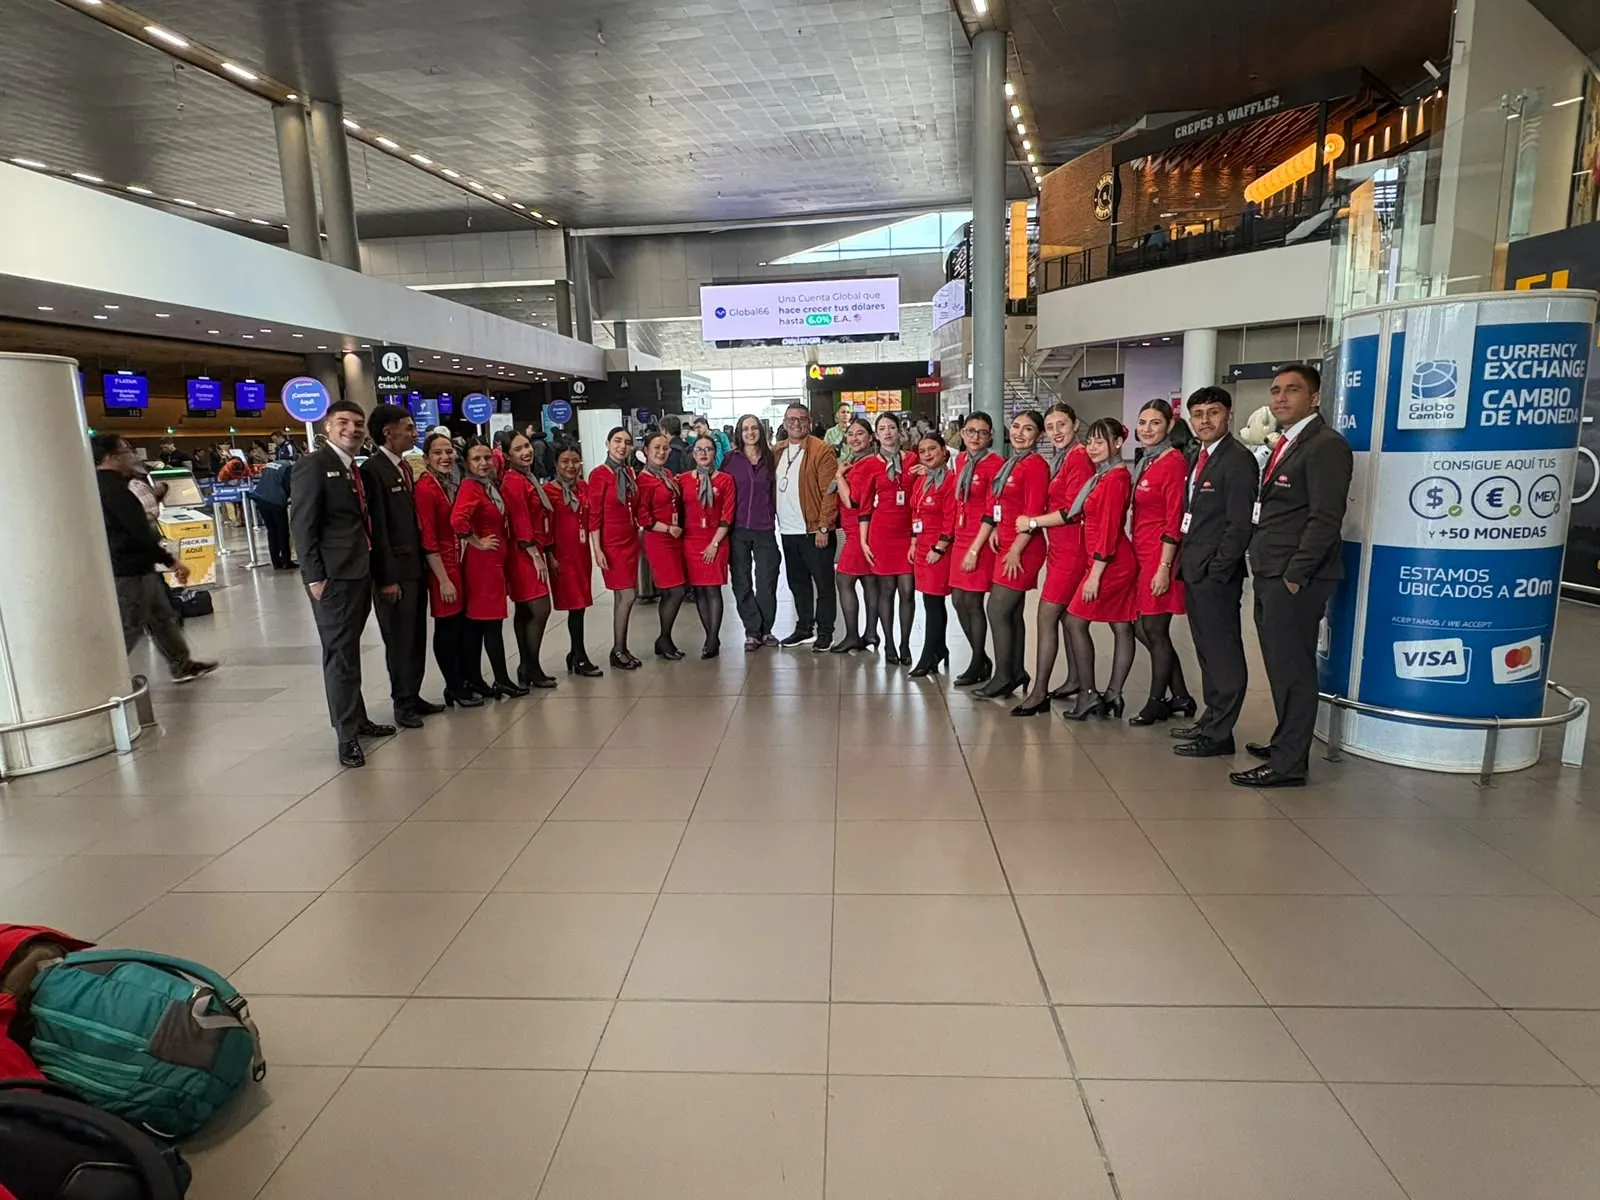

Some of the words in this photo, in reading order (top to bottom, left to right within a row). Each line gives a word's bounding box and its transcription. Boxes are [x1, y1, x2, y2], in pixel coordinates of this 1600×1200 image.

[1175, 116, 1214, 139] CREPES
[1216, 113, 1225, 125] &
[1227, 95, 1280, 121] WAFFLES
[778, 295, 796, 304] Una
[800, 294, 831, 303] Cuenta
[832, 292, 861, 301] Global
[863, 292, 880, 301] que
[729, 308, 769, 317] Global66
[778, 306, 800, 314] hace
[803, 305, 832, 313] crecer
[834, 304, 849, 312] tus
[851, 302, 885, 311] dólares
[779, 316, 804, 325] hasta
[808, 316, 830, 324] 6.0%
[833, 315, 852, 323] E.A.
[1486, 343, 1578, 360] CURRENCY
[1483, 360, 1586, 380] EXCHANGE
[1482, 387, 1571, 409] CAMBIO
[1409, 403, 1455, 412] Globo
[1409, 411, 1454, 420] Cambio
[1480, 410, 1512, 426] DE
[1516, 407, 1579, 425] MONEDA
[1433, 460, 1502, 471] CONSIGUE
[1505, 457, 1535, 471] AQUÍ
[1538, 458, 1556, 469] TUS
[1534, 490, 1556, 503] MEX
[1439, 528, 1470, 540] +50
[1474, 526, 1548, 540] MONEDAS
[1400, 566, 1490, 583] ESTAMOS
[1399, 582, 1494, 599] UBICADOS
[1497, 585, 1510, 598] A
[1513, 577, 1553, 598] 20m
[1391, 616, 1440, 626] ACEPTAMOS
[1402, 650, 1457, 666] VISA
